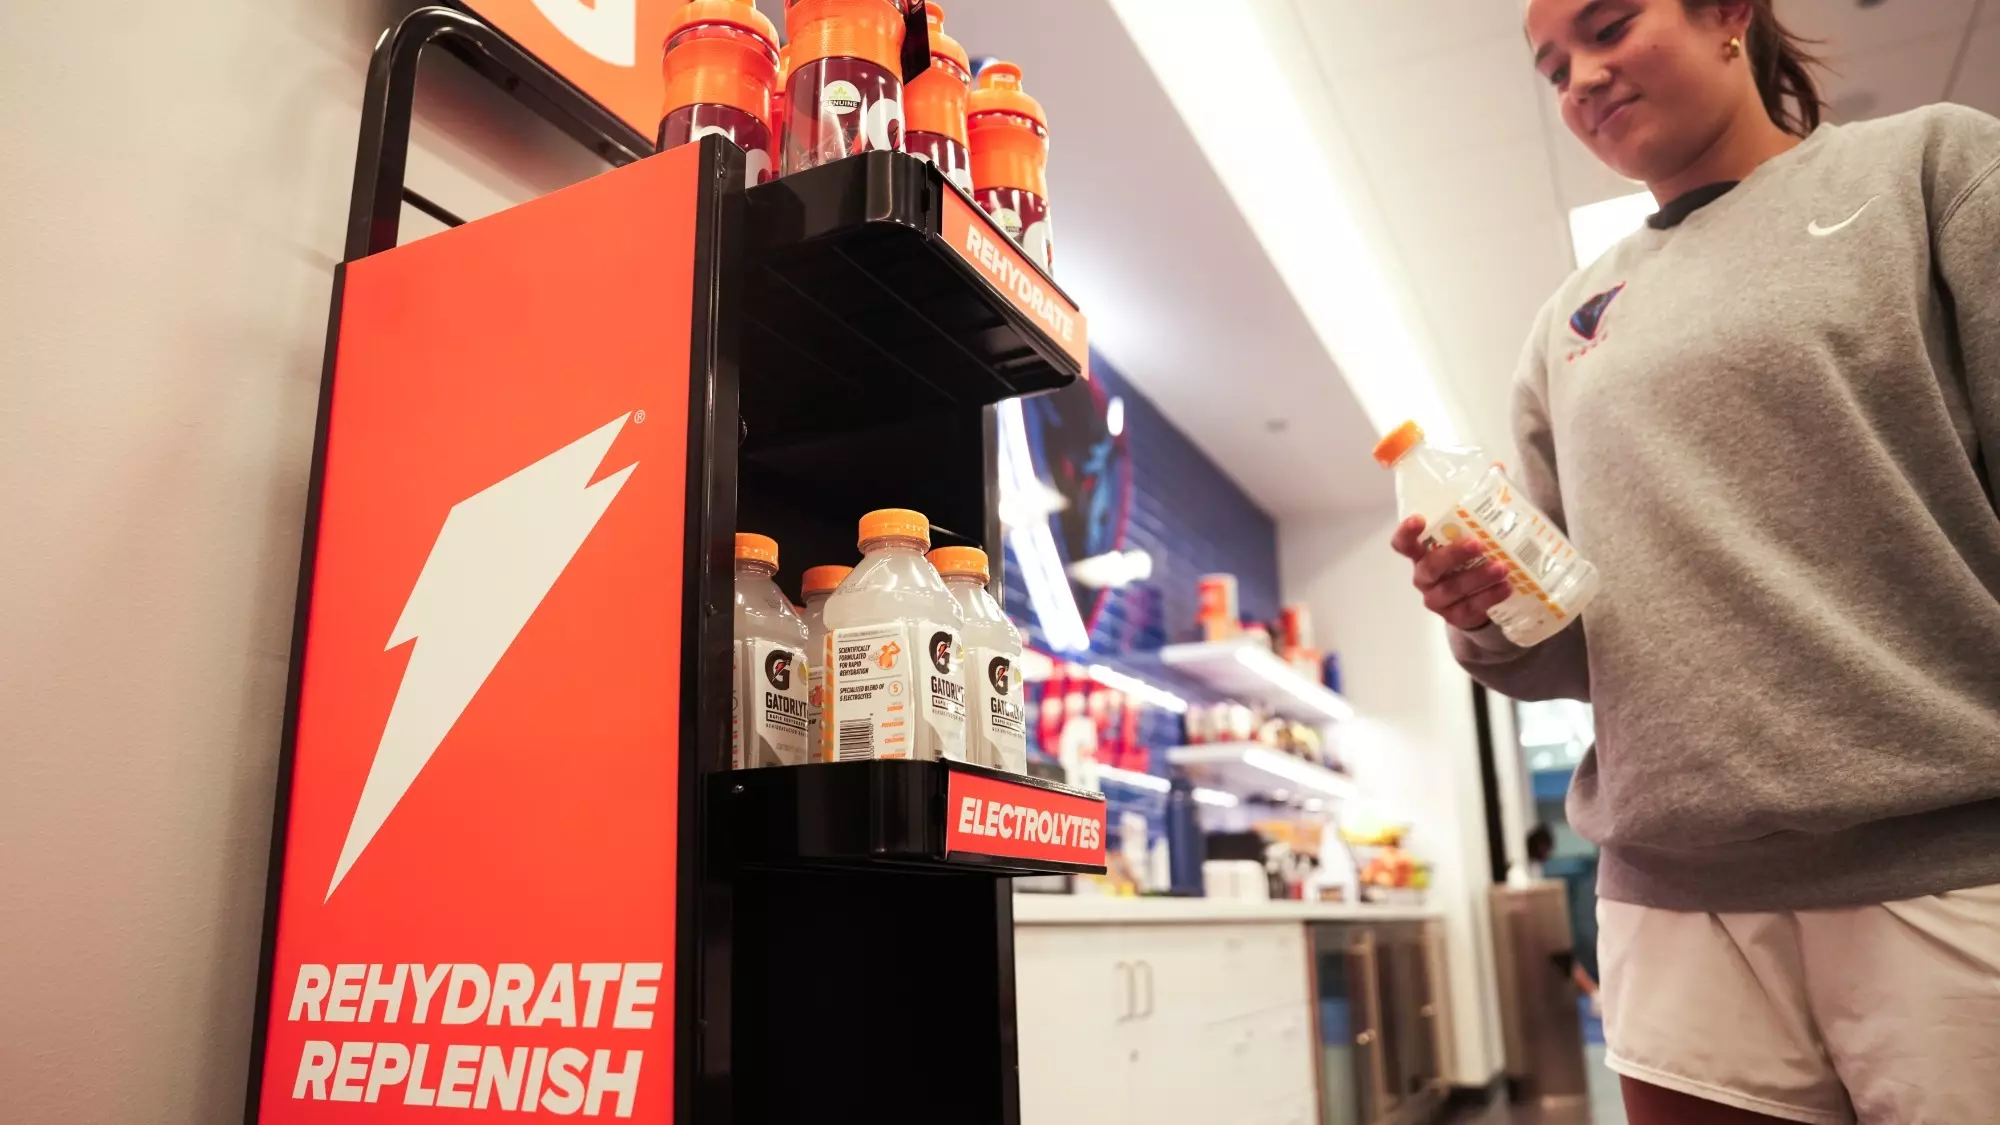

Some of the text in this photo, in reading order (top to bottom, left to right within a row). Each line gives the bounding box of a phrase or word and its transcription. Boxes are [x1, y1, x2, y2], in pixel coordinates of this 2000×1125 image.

[966, 224, 1074, 342] REHYDRATE
[765, 649, 793, 691] G
[839, 645, 871, 654] SCIENTIFICALLY
[839, 653, 867, 661] FORMULATED
[929, 630, 953, 675] G
[893, 683, 900, 693] 5
[988, 656, 1010, 696] G
[958, 796, 1101, 850] ELECTROLYTES
[288, 962, 663, 1029] REHYDRATE
[292, 1040, 644, 1118] REPLENISH
